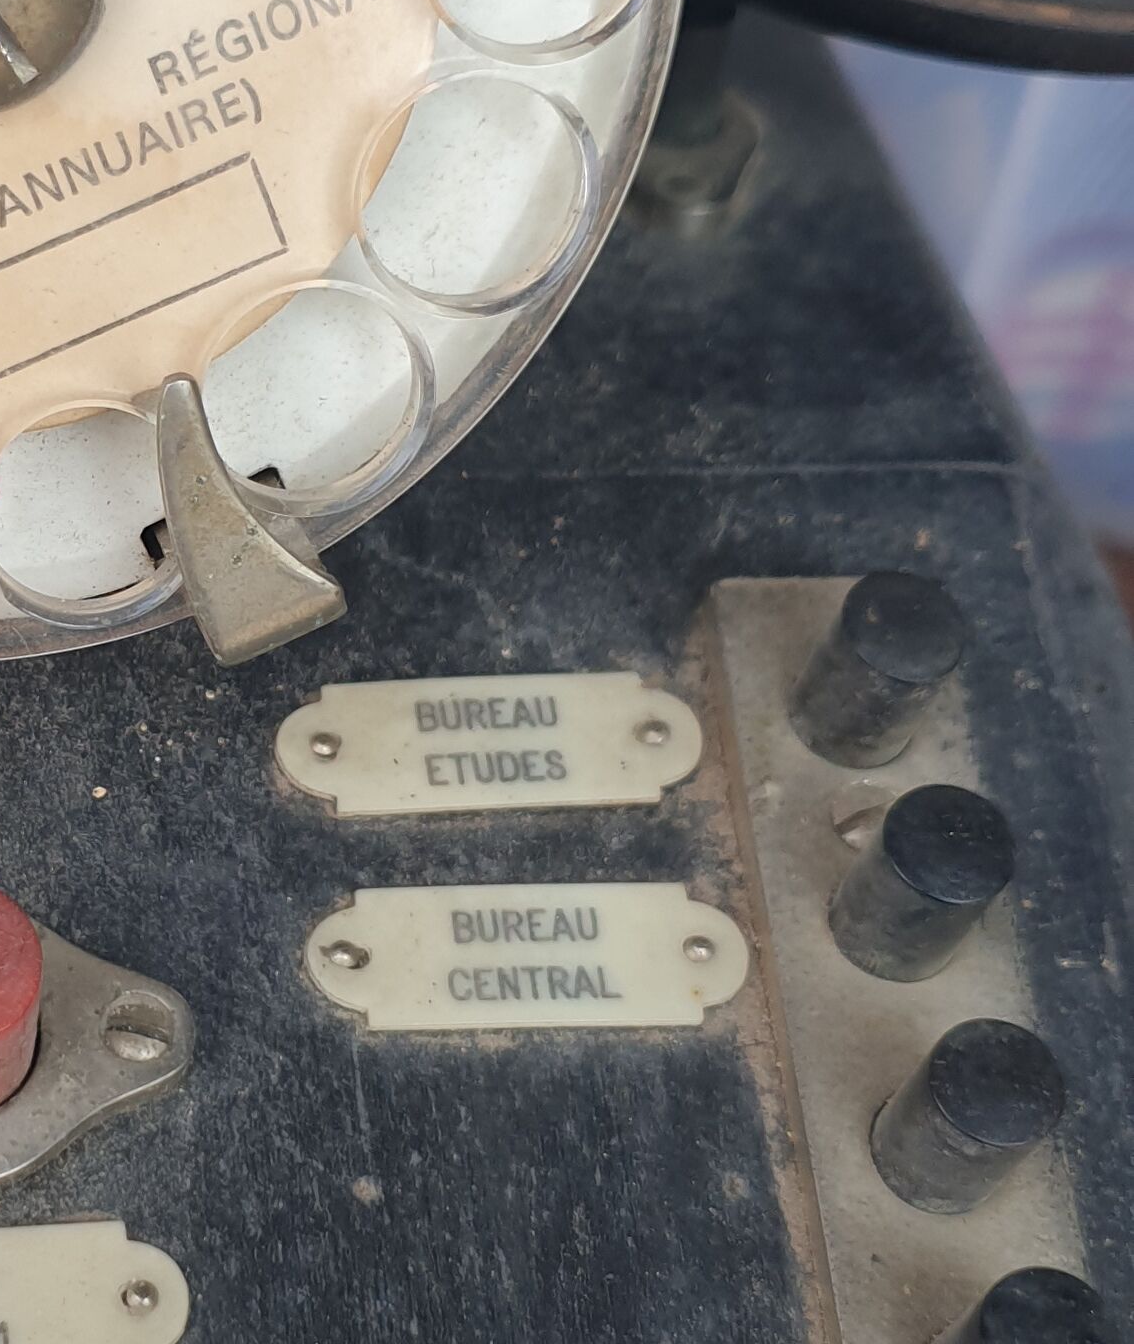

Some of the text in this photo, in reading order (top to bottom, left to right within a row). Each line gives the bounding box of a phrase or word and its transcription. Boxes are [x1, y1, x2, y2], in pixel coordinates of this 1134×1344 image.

[414, 695, 559, 733] BUREAU
[424, 750, 568, 787] ETUDES
[451, 906, 599, 944] BUREAU
[448, 964, 623, 1002] CENTRAL
